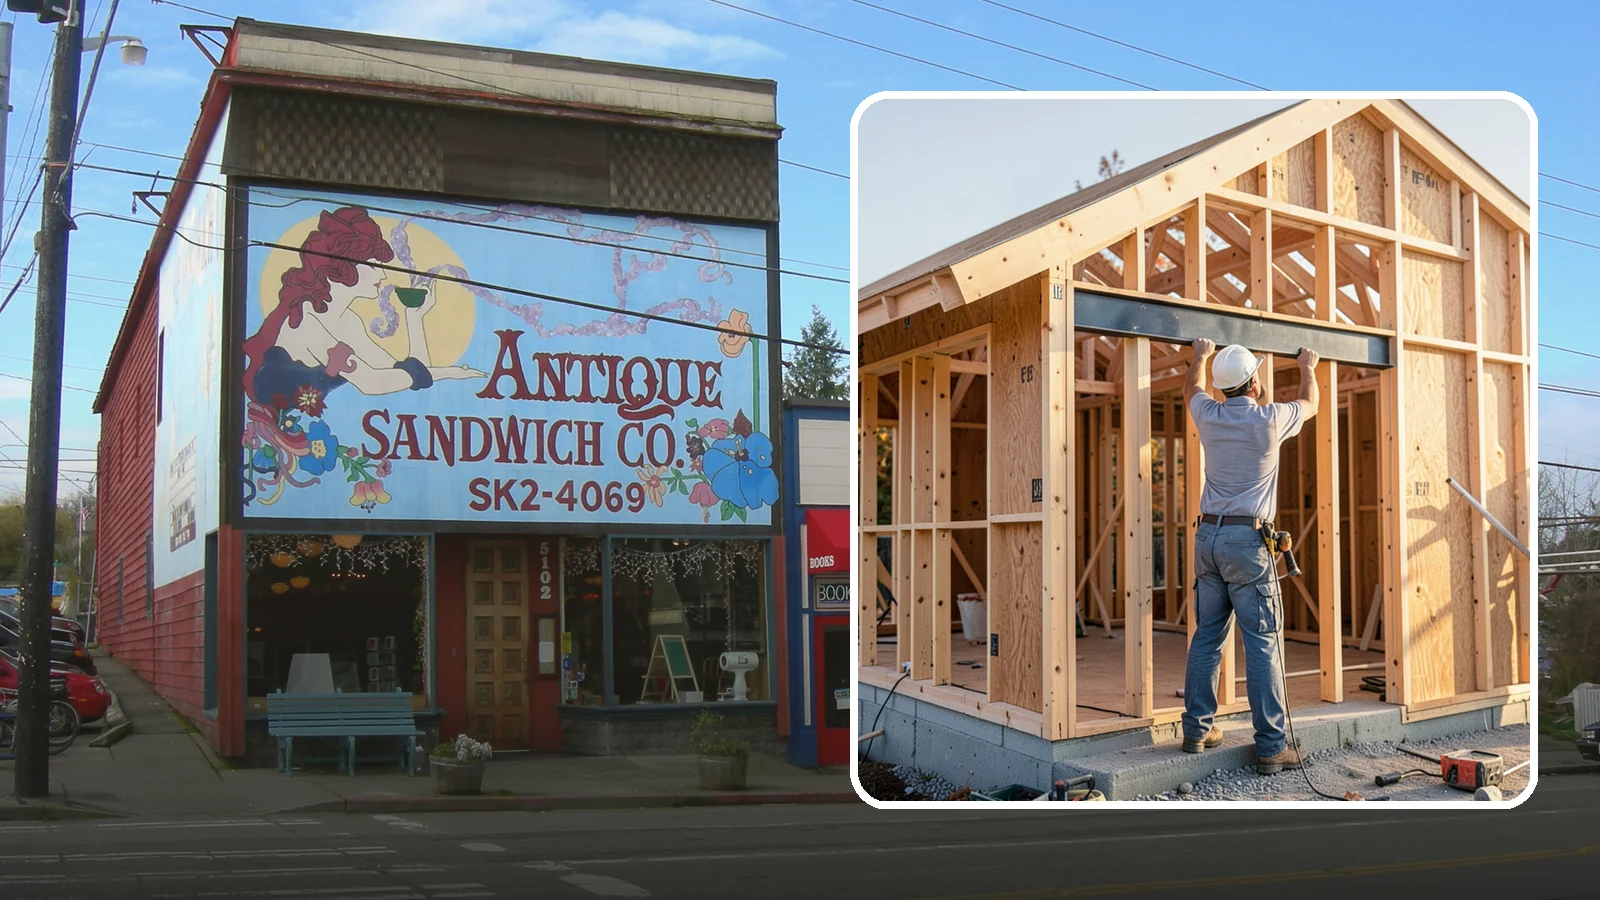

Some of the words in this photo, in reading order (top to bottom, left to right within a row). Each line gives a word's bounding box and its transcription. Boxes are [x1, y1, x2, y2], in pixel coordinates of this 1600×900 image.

[476, 329, 723, 420] ANTIQUE
[361, 408, 604, 467] SANDWICH
[617, 421, 685, 469] CO.
[468, 477, 646, 513] SK2-4069
[540, 542, 551, 600] 5102
[809, 555, 835, 569] BOOKS
